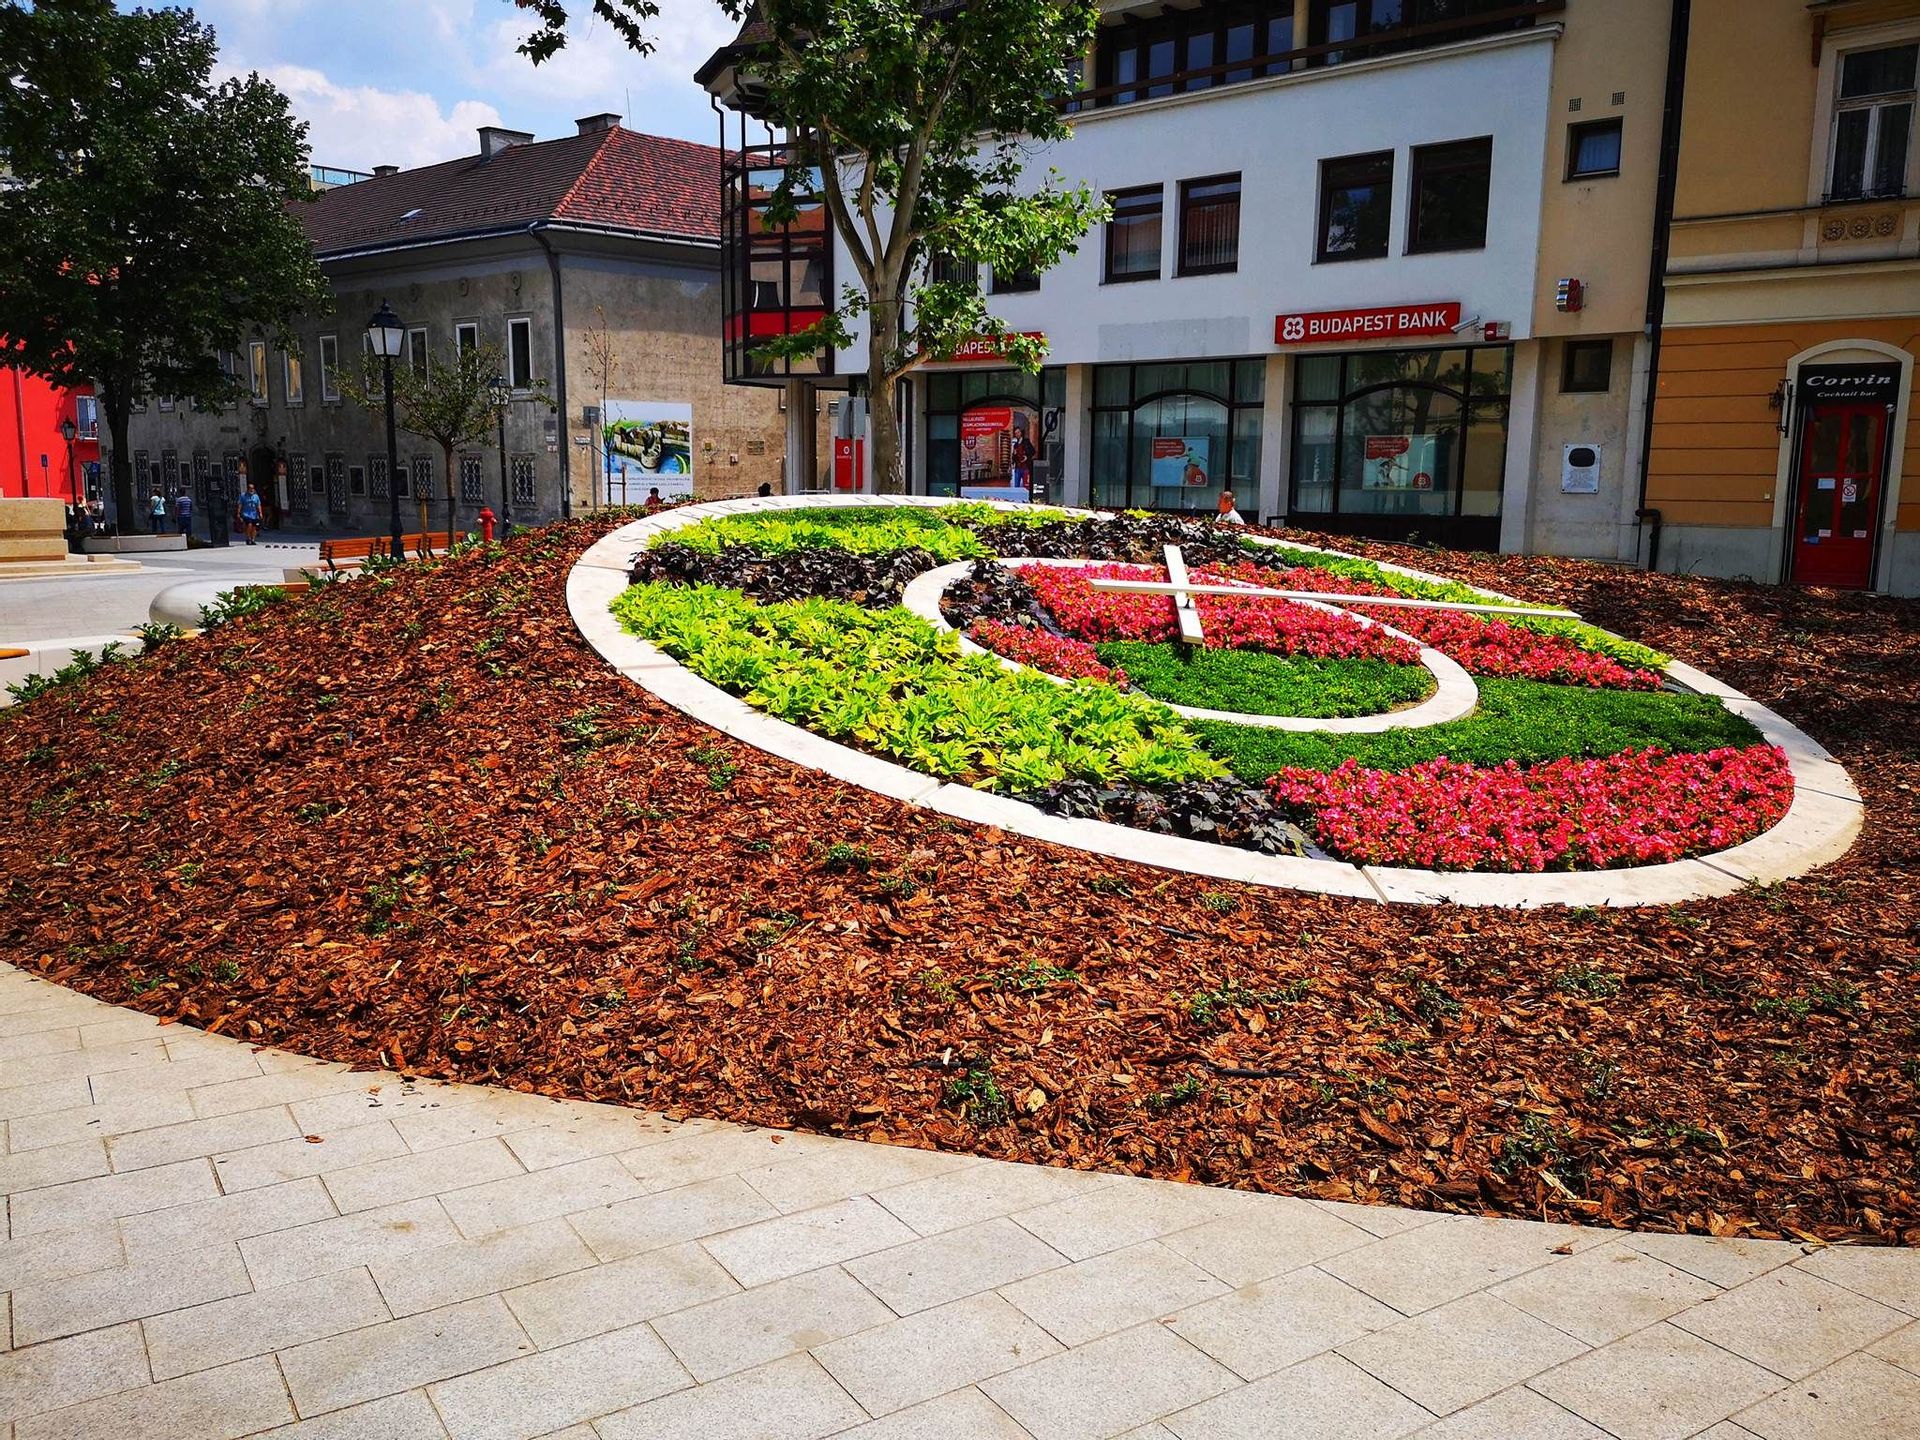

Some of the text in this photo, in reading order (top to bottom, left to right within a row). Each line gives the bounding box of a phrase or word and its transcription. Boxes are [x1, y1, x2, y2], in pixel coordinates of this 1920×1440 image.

[1309, 310, 1447, 335] BUDAPEST BANK
[1806, 374, 1891, 386] Corvin
